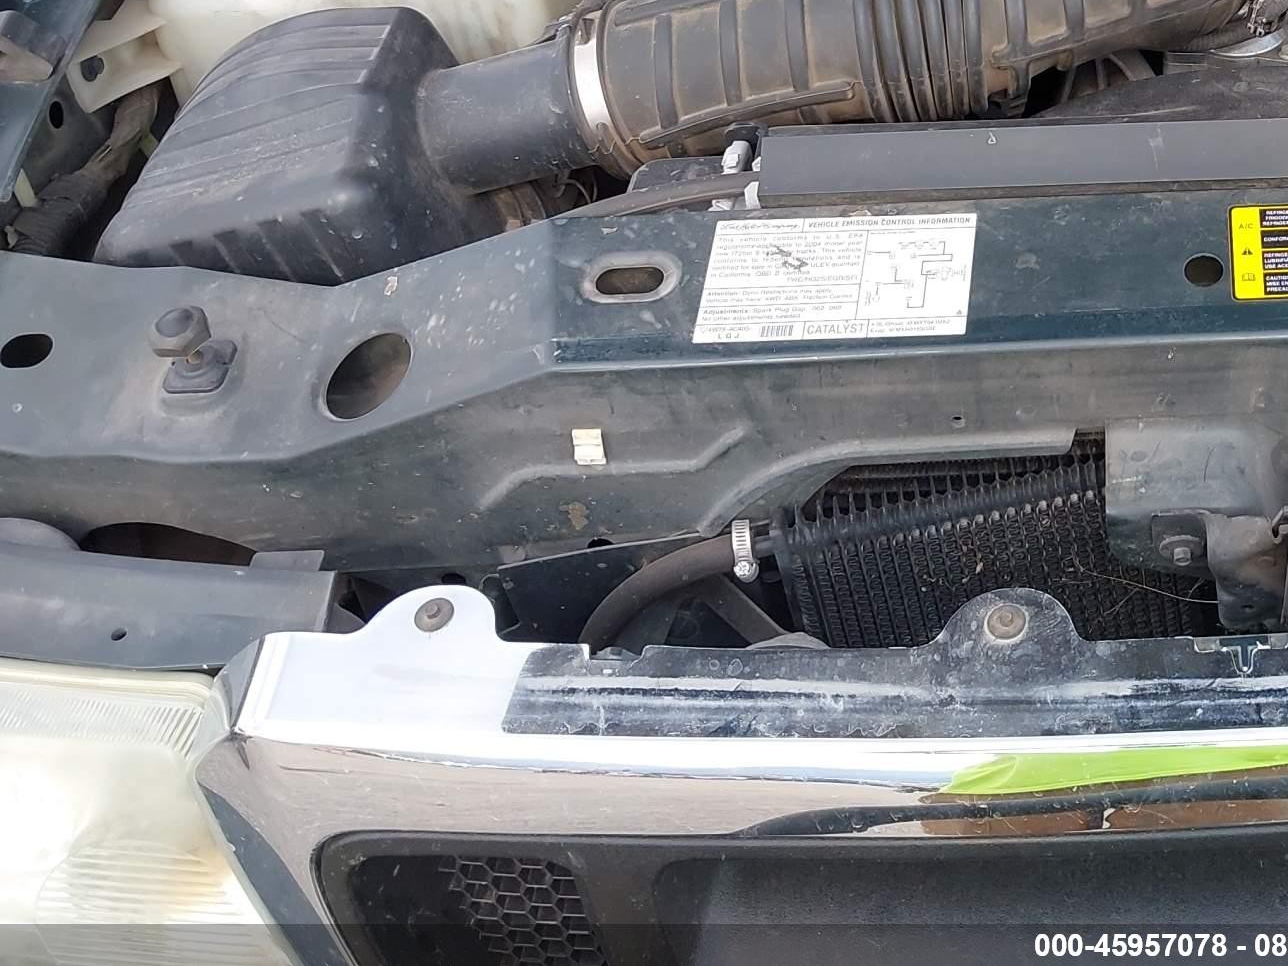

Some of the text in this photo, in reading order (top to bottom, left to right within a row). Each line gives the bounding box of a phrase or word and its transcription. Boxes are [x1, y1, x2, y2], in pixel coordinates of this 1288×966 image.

[808, 220, 840, 228] VEHICLE
[881, 218, 915, 226] CONTROL
[918, 216, 971, 224] INFORMATION
[806, 323, 864, 335] CATALYST
